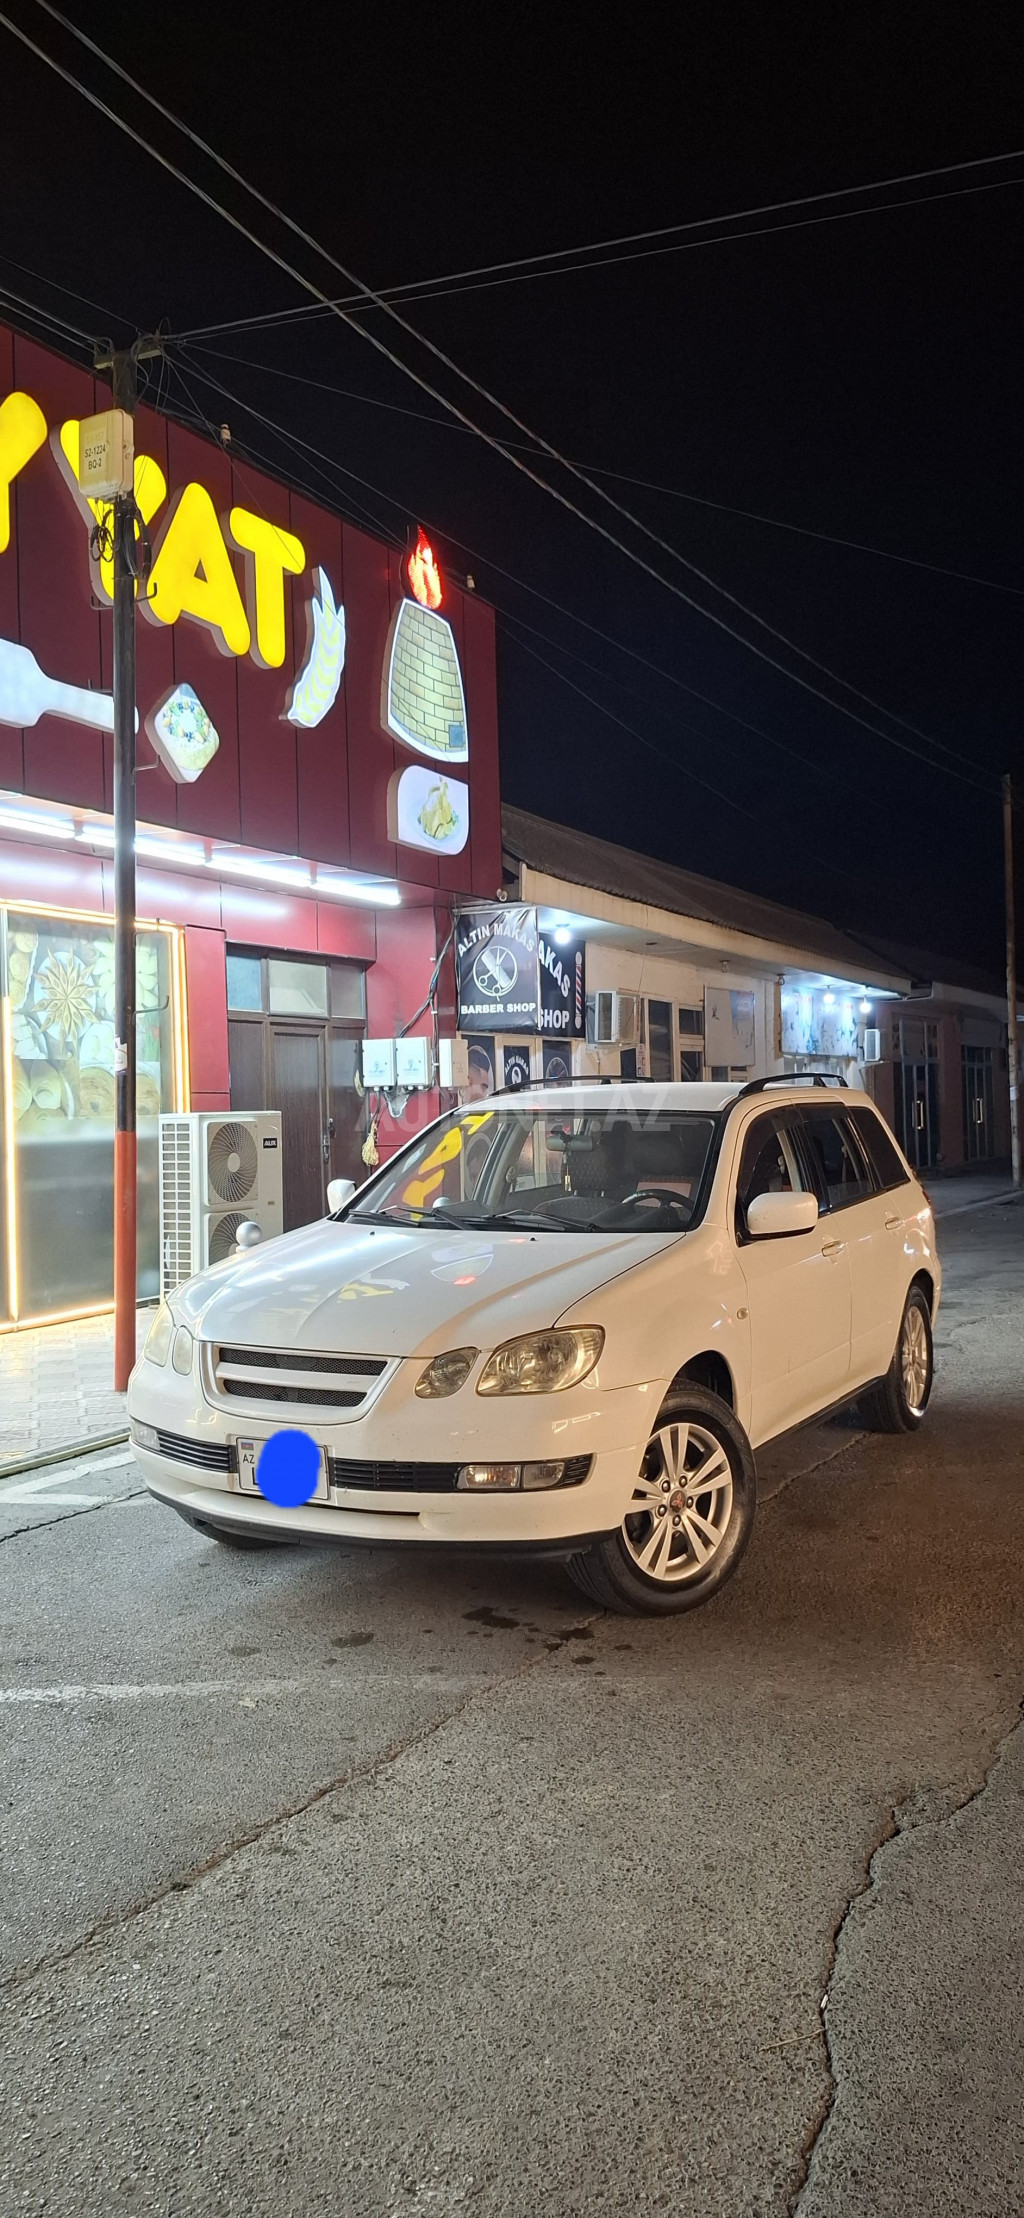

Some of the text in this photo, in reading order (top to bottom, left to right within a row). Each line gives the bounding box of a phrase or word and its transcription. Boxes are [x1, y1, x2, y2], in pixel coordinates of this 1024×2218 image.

[84, 444, 106, 458] S2-1224
[457, 923, 535, 958] ALTIN MAKAS
[461, 1002, 536, 1015] BARBER SHOP
[242, 1453, 255, 1465] AZ
